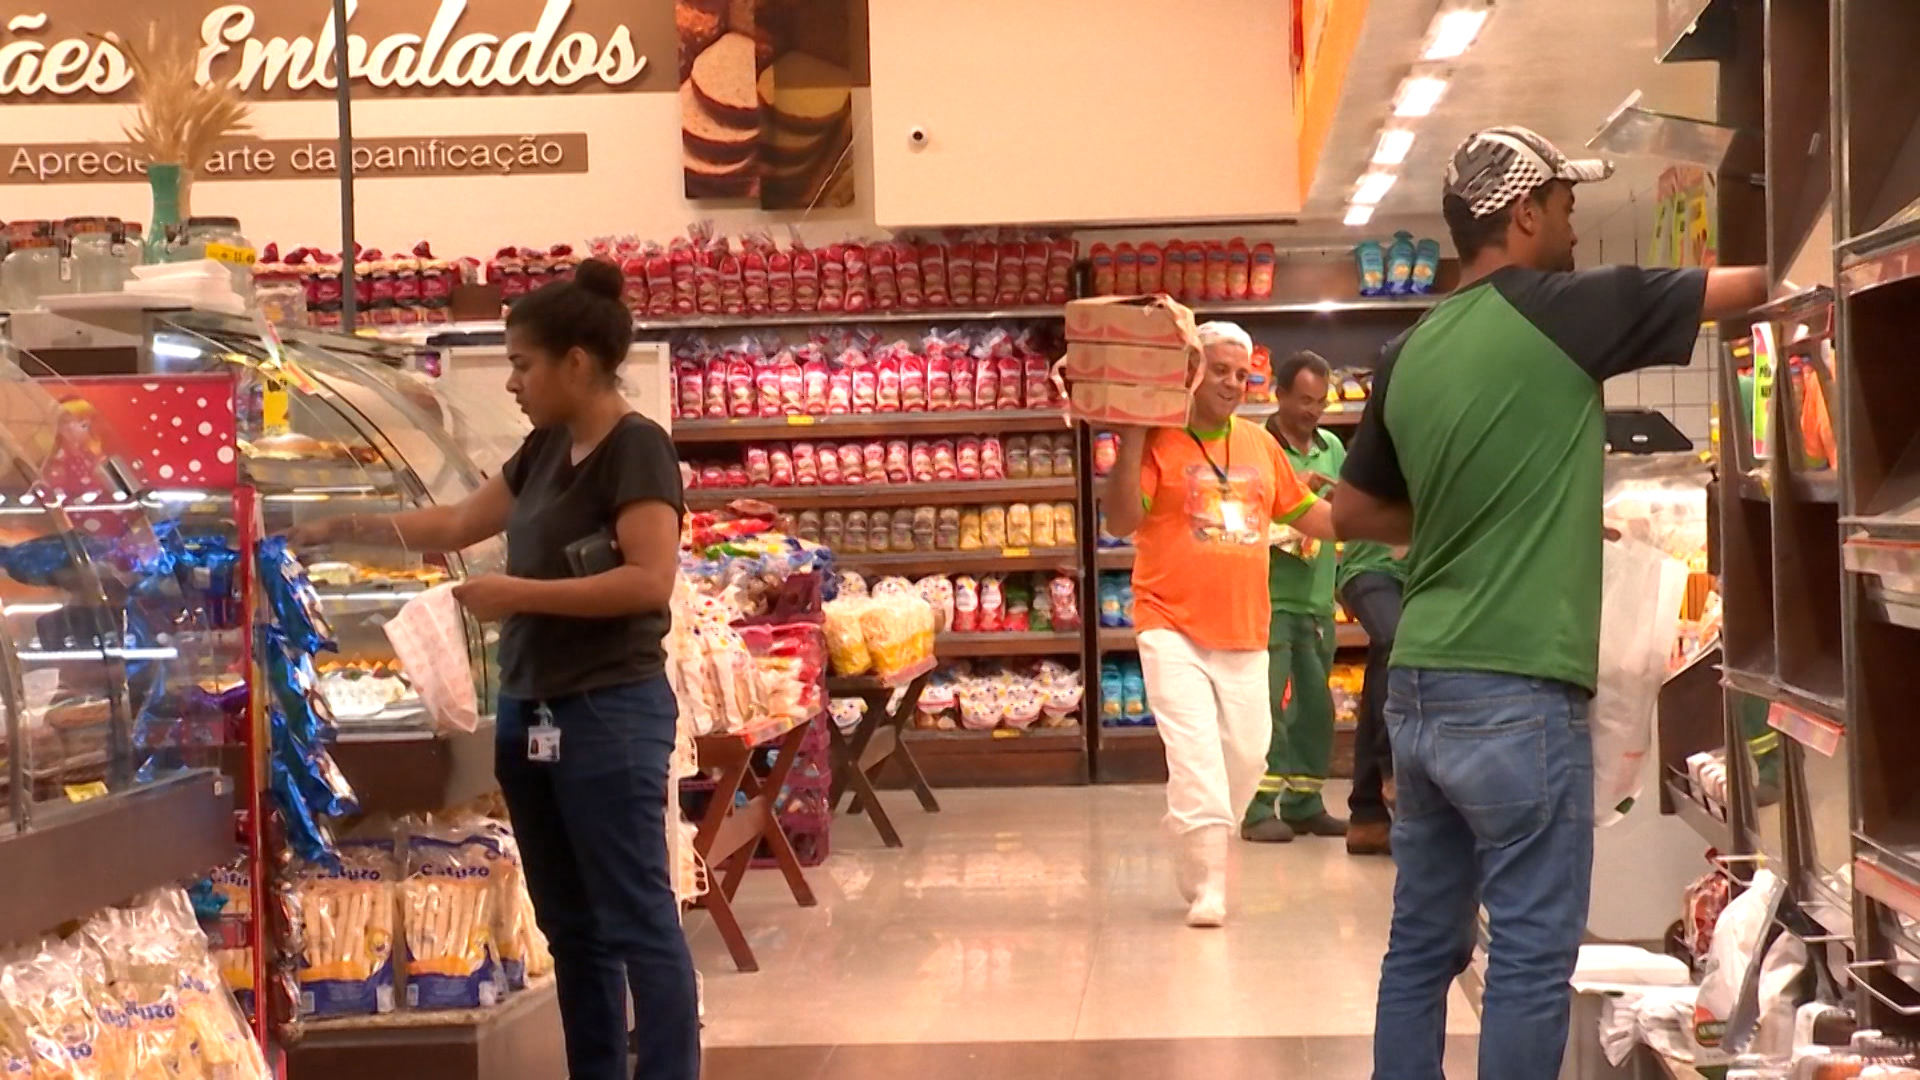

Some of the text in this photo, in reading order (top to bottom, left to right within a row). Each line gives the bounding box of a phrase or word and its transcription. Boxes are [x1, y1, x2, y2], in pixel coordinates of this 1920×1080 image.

[0, 0, 647, 94] ães Embalados
[204, 145, 276, 173] arte
[290, 143, 337, 170] da
[352, 134, 564, 175] panificação
